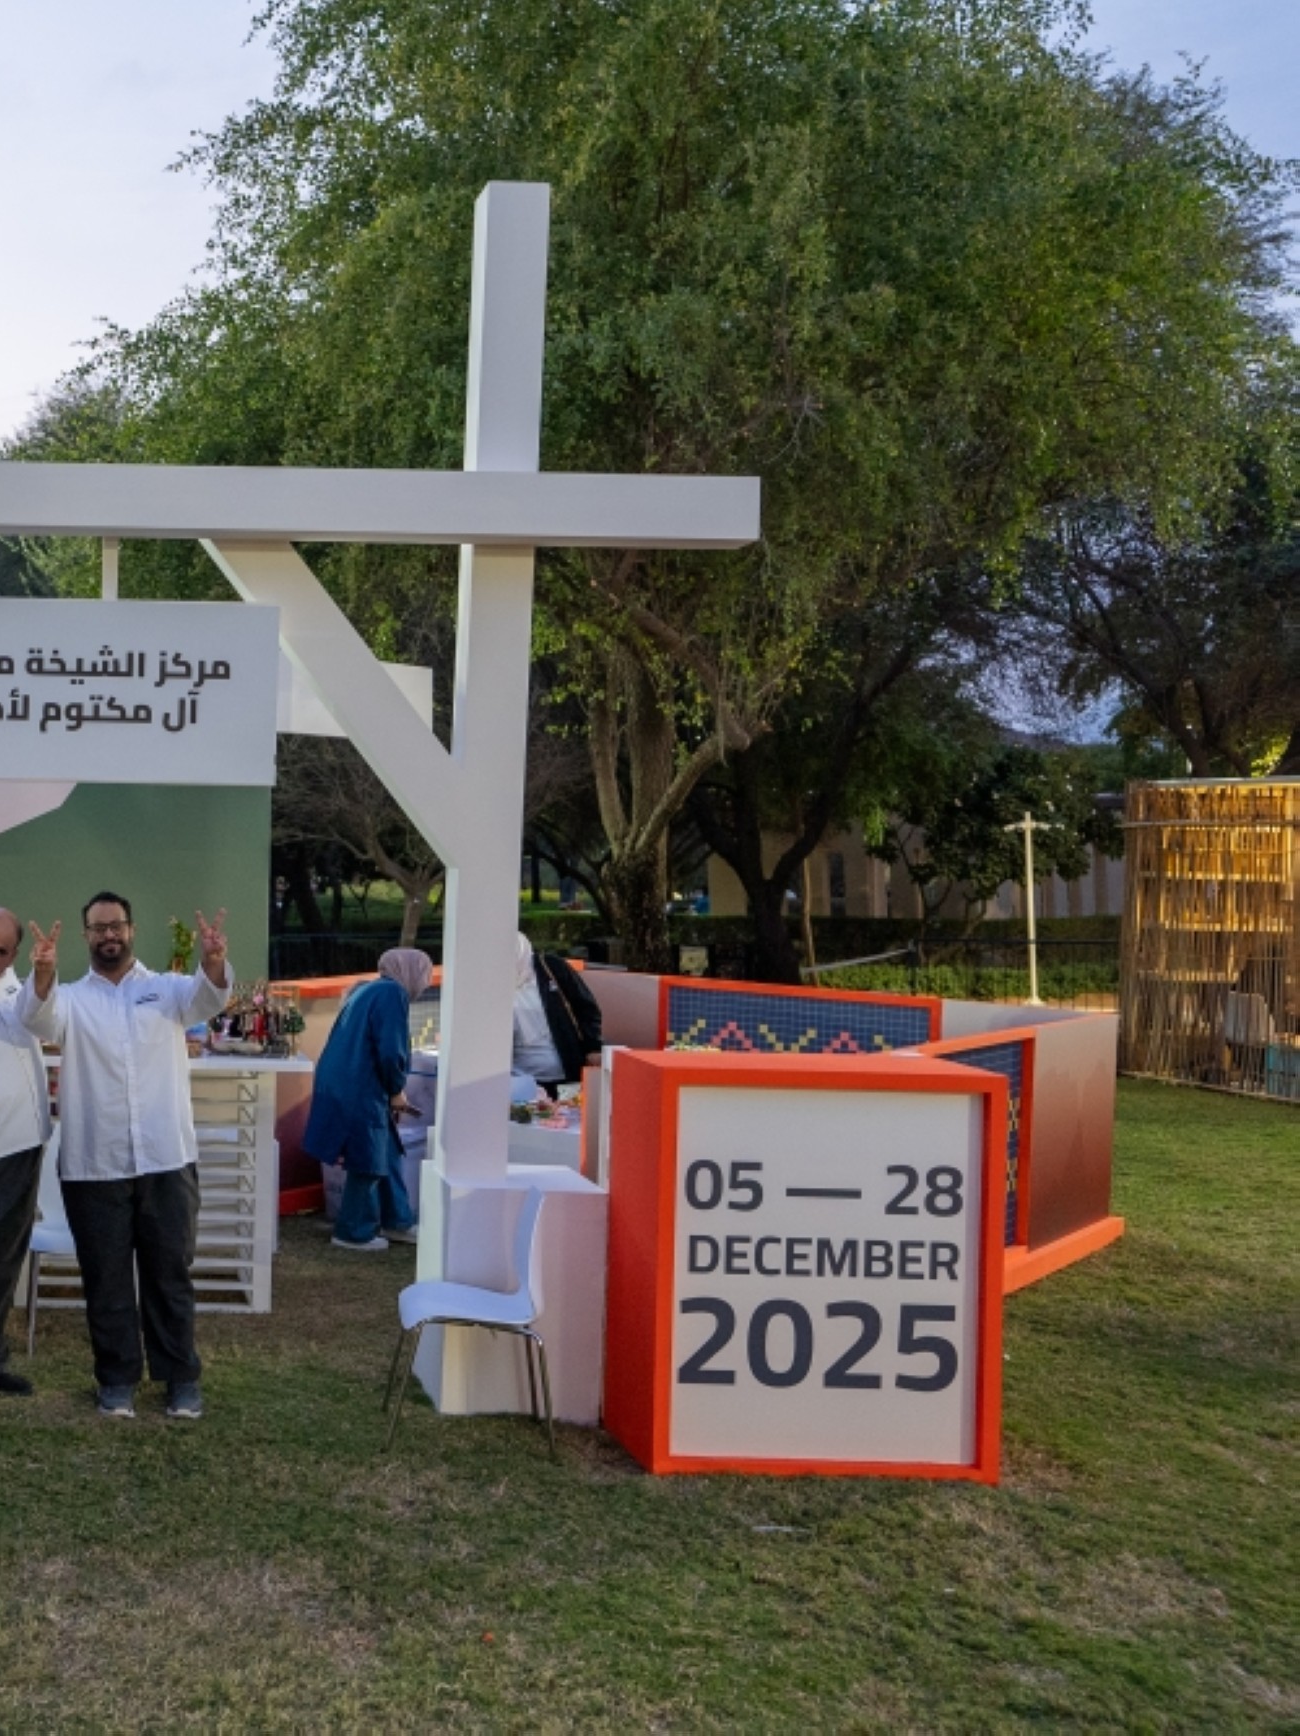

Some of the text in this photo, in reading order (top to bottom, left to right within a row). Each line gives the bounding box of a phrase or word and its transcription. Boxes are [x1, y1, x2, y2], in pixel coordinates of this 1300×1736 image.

[25, 644, 146, 684] الشيخة
[154, 650, 231, 689] مركز
[39, 694, 153, 733] مكتوم
[162, 690, 200, 733] آل
[684, 1159, 764, 1212] 05
[884, 1164, 964, 1218] 28
[687, 1234, 960, 1281] DECEMBER
[677, 1296, 959, 1393] 2025
